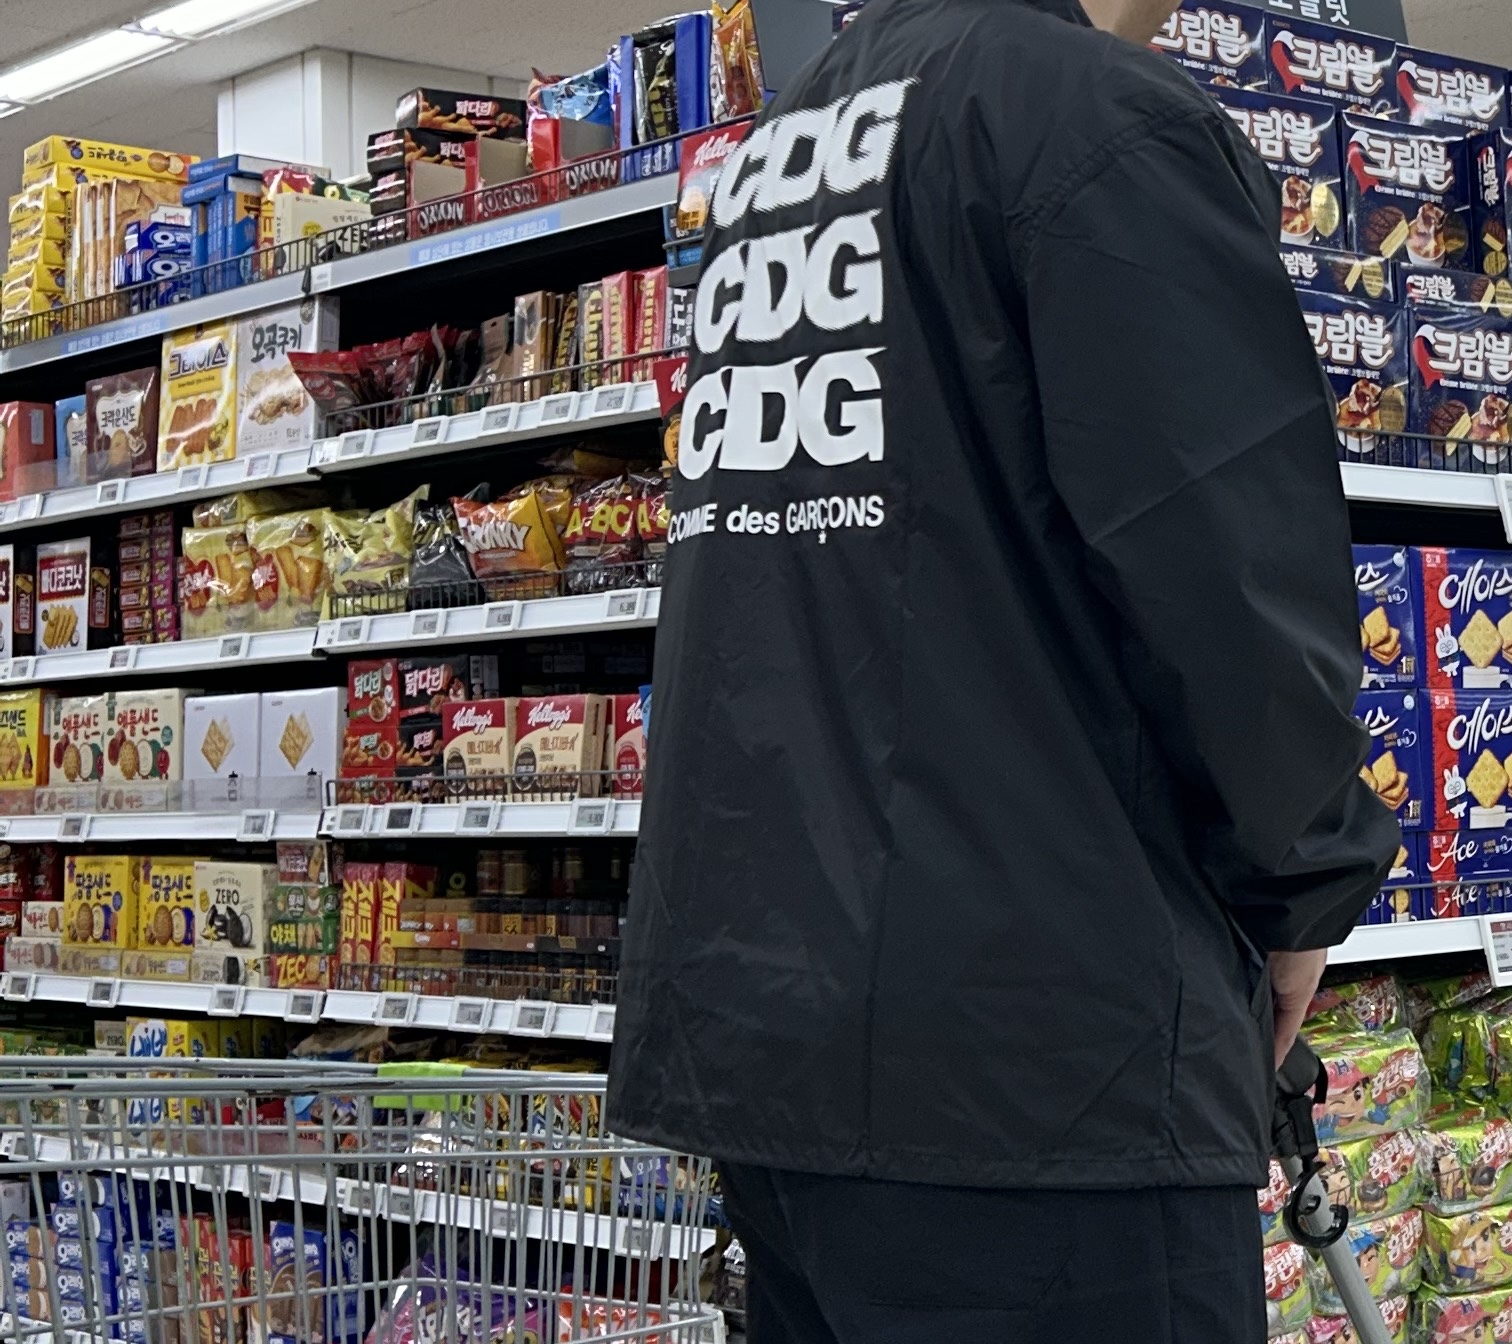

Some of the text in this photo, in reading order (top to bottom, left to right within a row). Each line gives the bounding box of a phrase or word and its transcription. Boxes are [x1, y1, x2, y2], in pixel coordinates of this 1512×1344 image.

[1289, 38, 1384, 97] 크림블
[1413, 69, 1499, 122] 크림블
[712, 78, 920, 230] CDG
[1363, 137, 1454, 193] 크림블
[694, 209, 884, 355] CDG
[251, 324, 302, 364] 오곡쿠키
[678, 347, 887, 481] CDG
[726, 505, 780, 535] des
[786, 495, 885, 535] GARÇONS
[528, 700, 572, 731] Kellogg's
[1427, 831, 1479, 872] Ace
[1371, 1049, 1421, 1104] 홈런볼
[1385, 1210, 1424, 1264] 홈런볼
